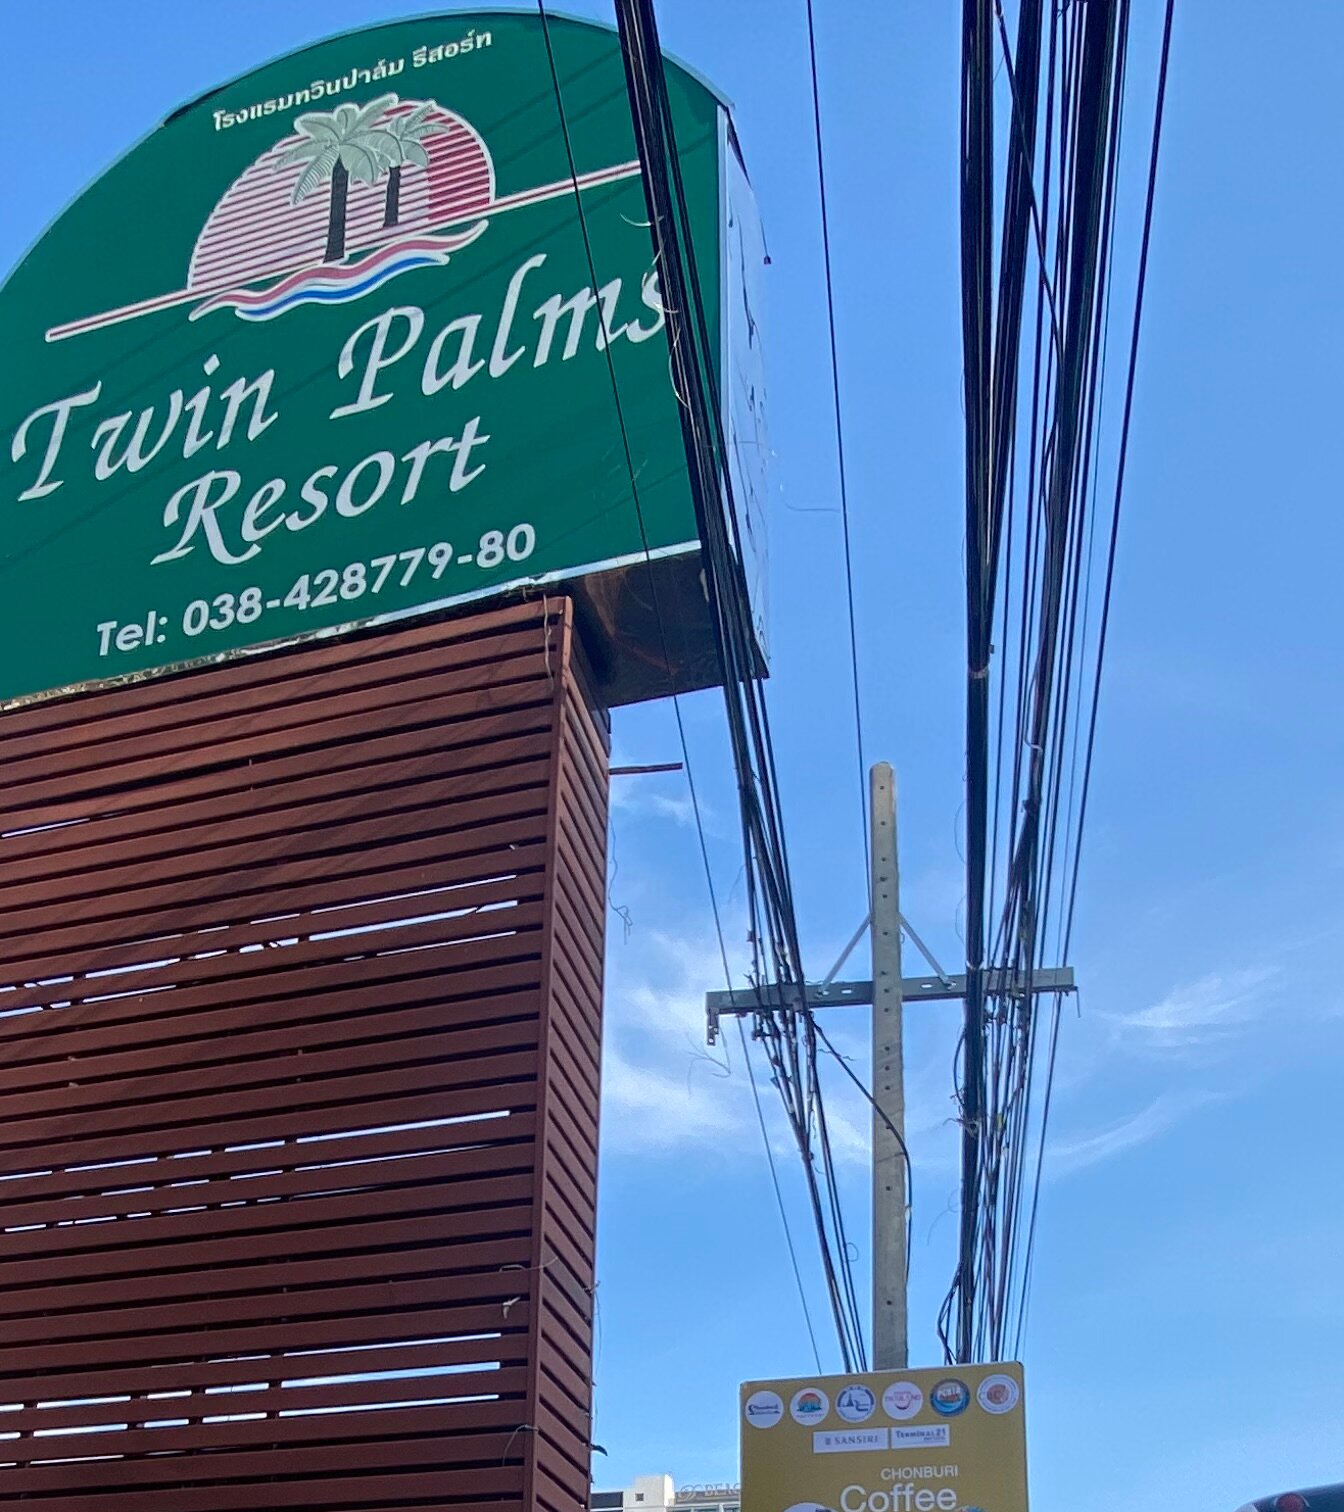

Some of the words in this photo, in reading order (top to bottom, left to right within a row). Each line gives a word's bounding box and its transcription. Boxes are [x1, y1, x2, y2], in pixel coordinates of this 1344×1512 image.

[213, 57, 404, 131] โรงแรมทวินปาล์ม
[413, 28, 492, 68] รีสอร์ท
[10, 353, 279, 502] Twin
[329, 254, 667, 420] Palms
[151, 416, 492, 568] Resort
[97, 614, 167, 658] Tel:
[183, 522, 537, 639] 038-428779-80
[880, 1464, 958, 1481] CHONBURI
